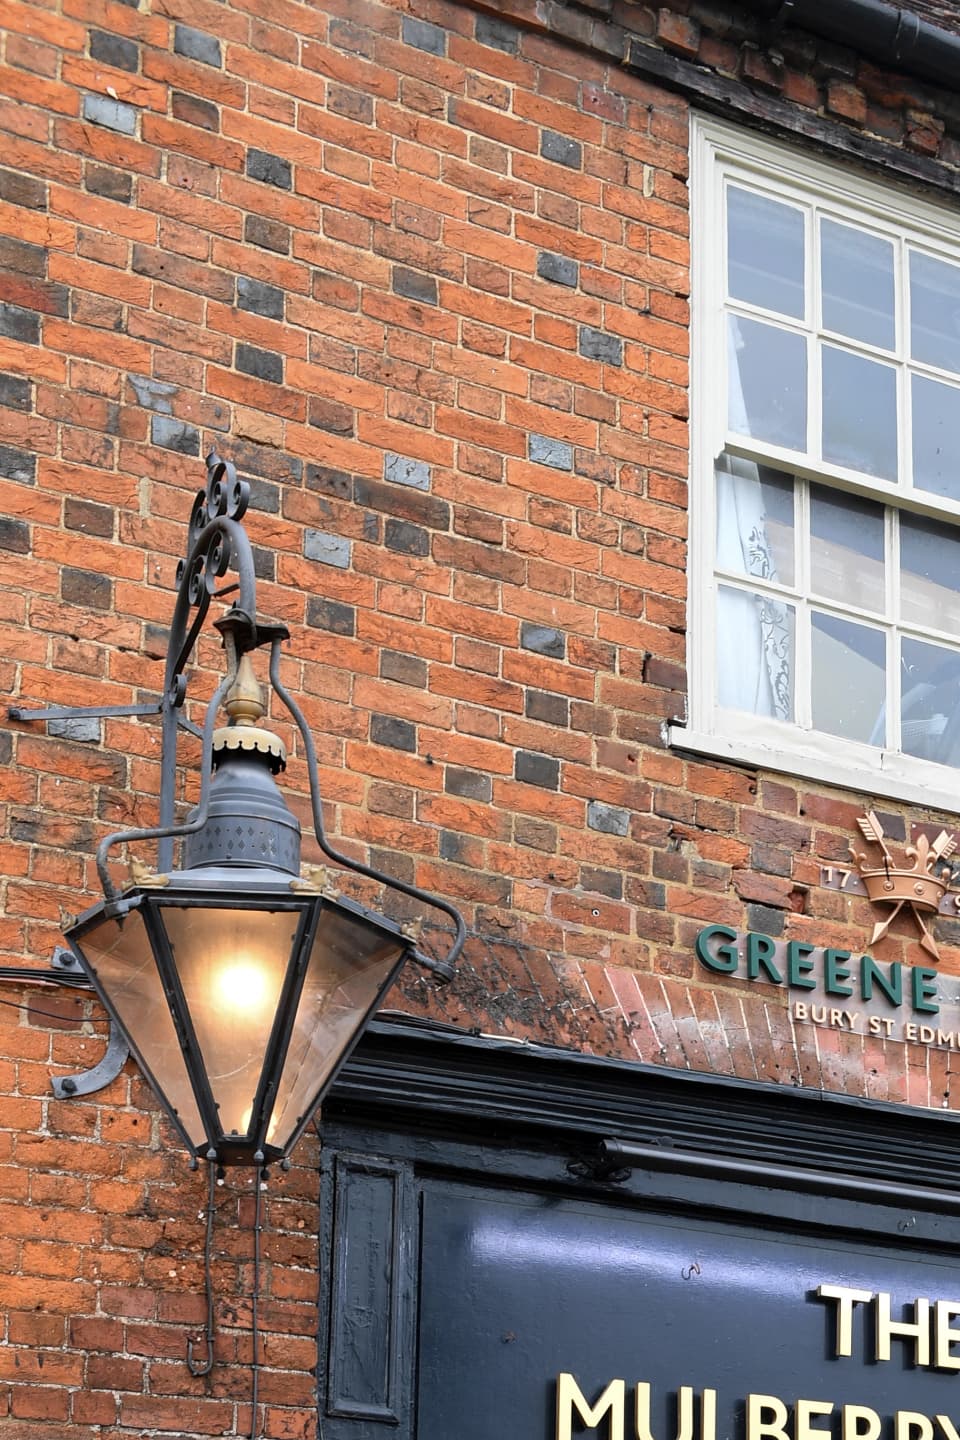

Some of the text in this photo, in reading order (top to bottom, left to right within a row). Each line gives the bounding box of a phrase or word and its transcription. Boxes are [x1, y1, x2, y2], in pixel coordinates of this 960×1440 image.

[821, 866, 851, 889] 17
[695, 924, 940, 1014] GREENE
[794, 1000, 859, 1031] BURY
[869, 1014, 896, 1038] ST
